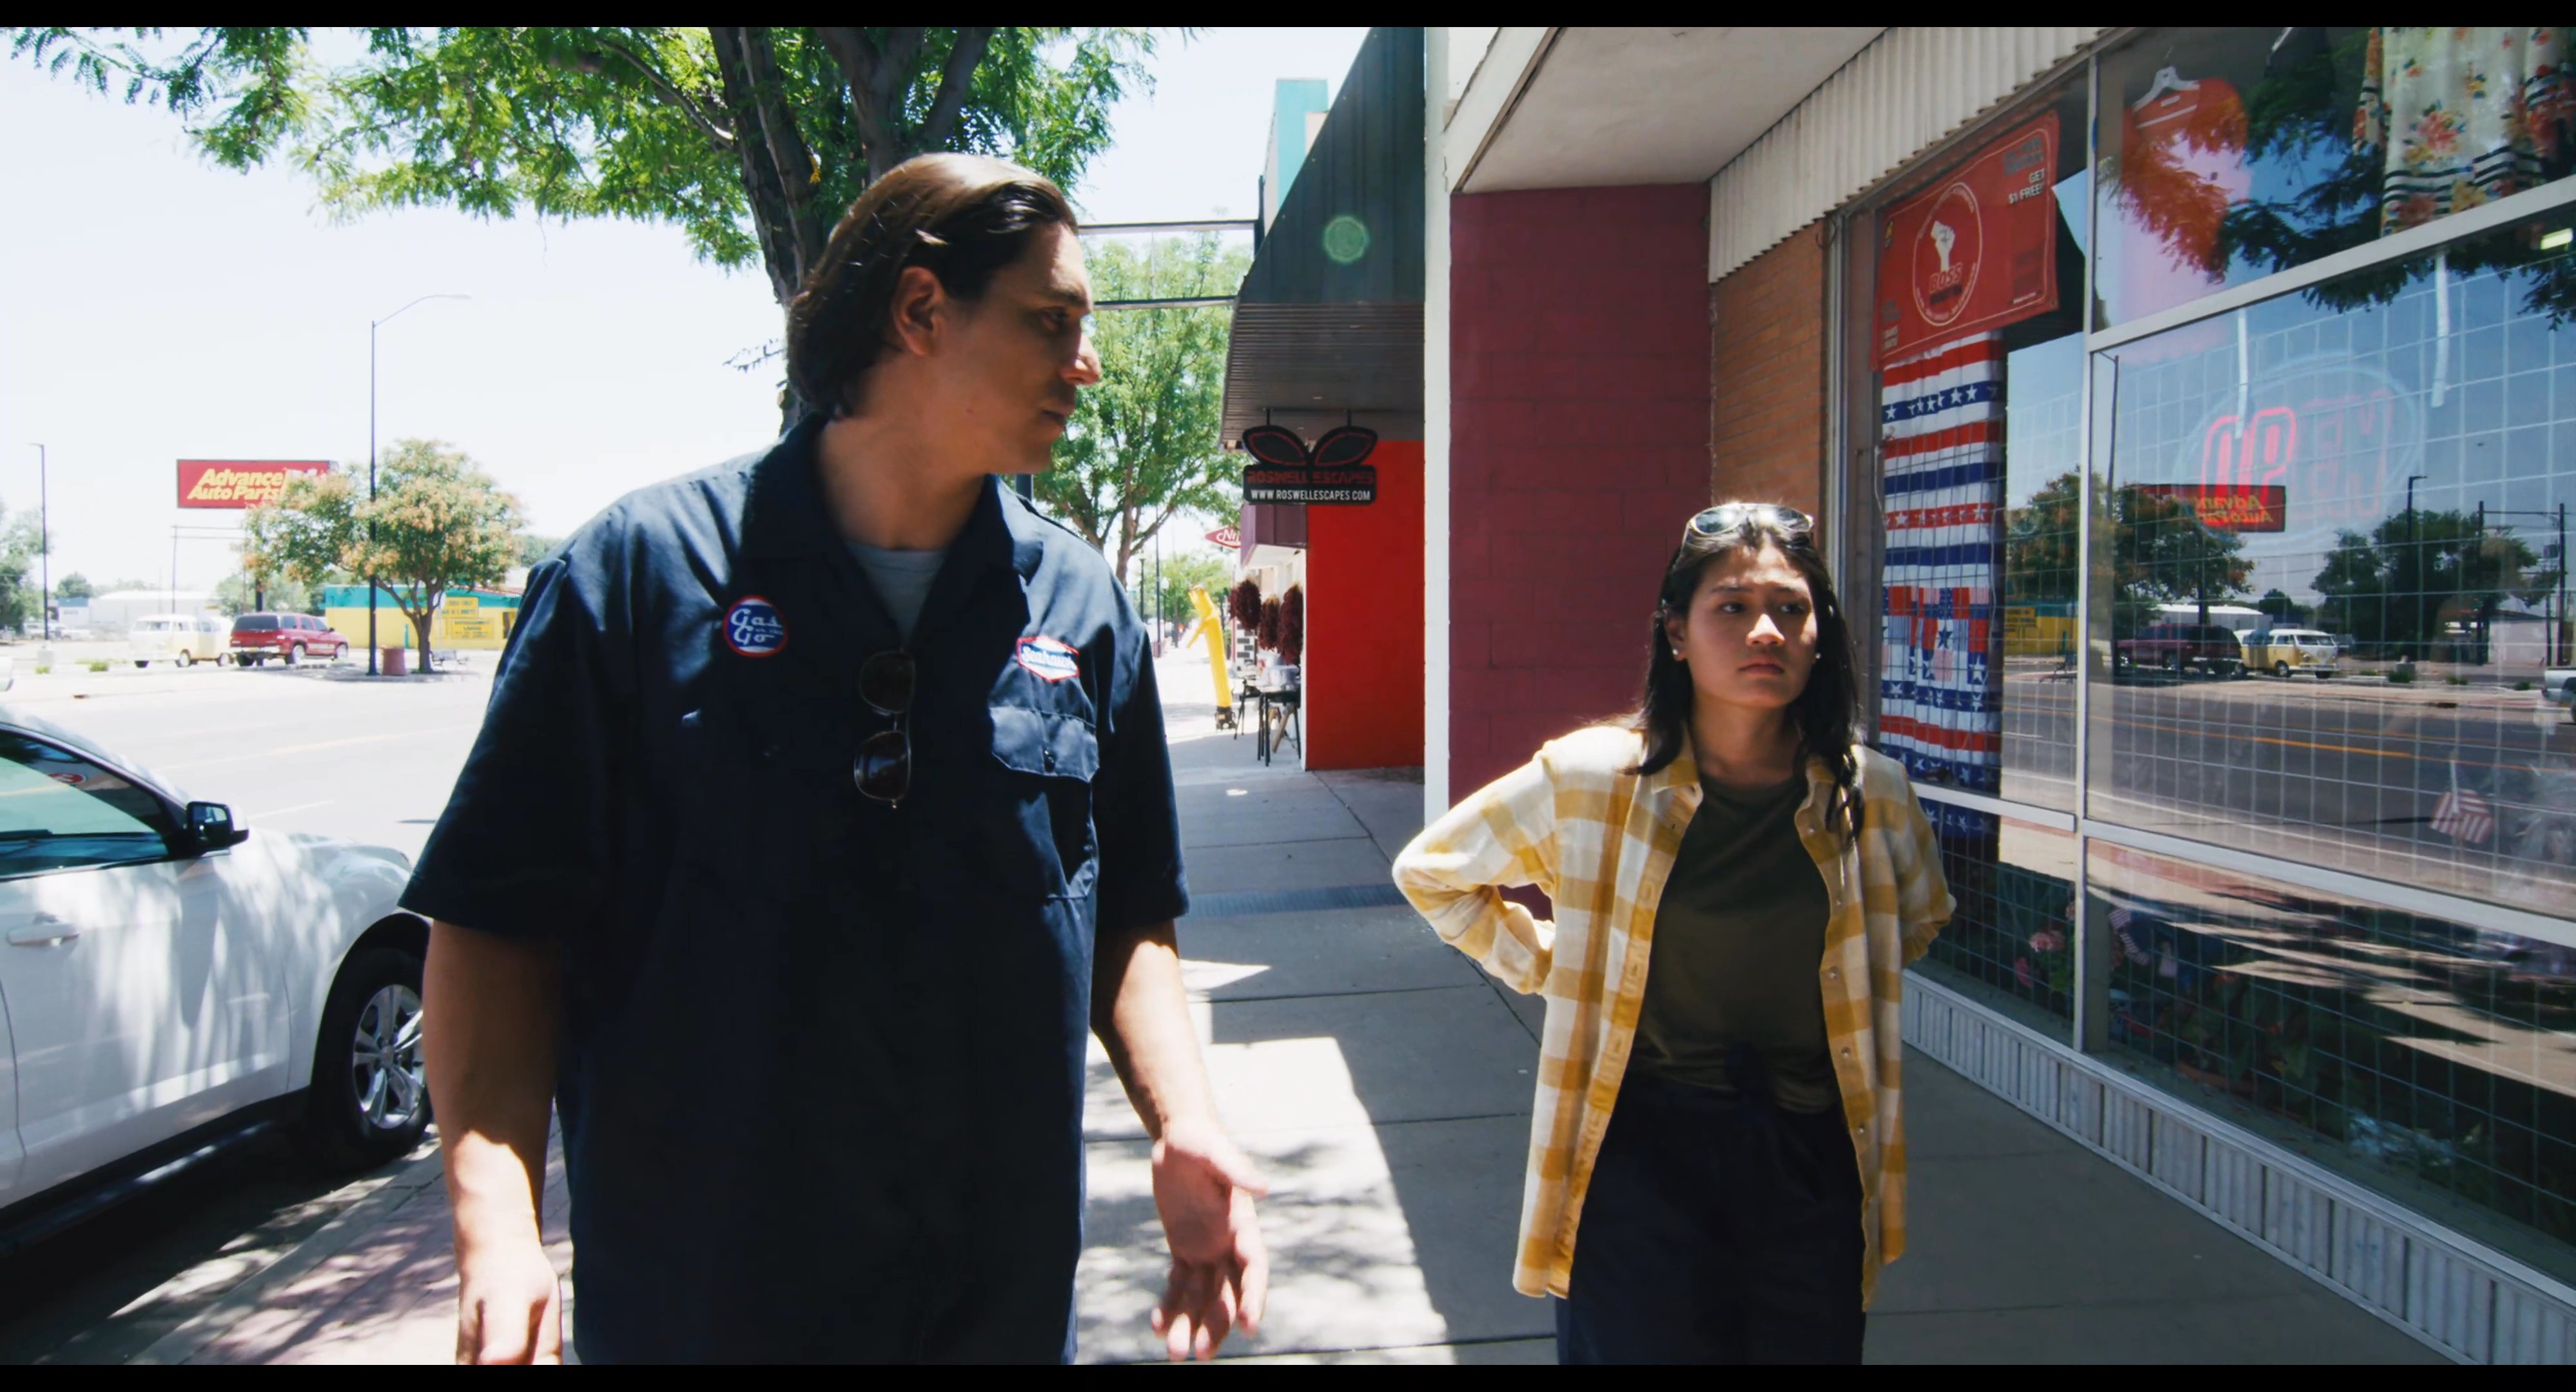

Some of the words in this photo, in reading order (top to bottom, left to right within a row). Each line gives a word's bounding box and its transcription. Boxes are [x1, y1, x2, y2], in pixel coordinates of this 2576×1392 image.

[1929, 262, 1963, 294] BOSS
[199, 469, 284, 487] Advance
[1247, 470, 1309, 485] ROSWELL
[1312, 470, 1374, 485] ESCAPES
[187, 485, 234, 501] Auto
[231, 485, 281, 501] Parts
[730, 608, 783, 627] Gas
[733, 626, 776, 645] Go
